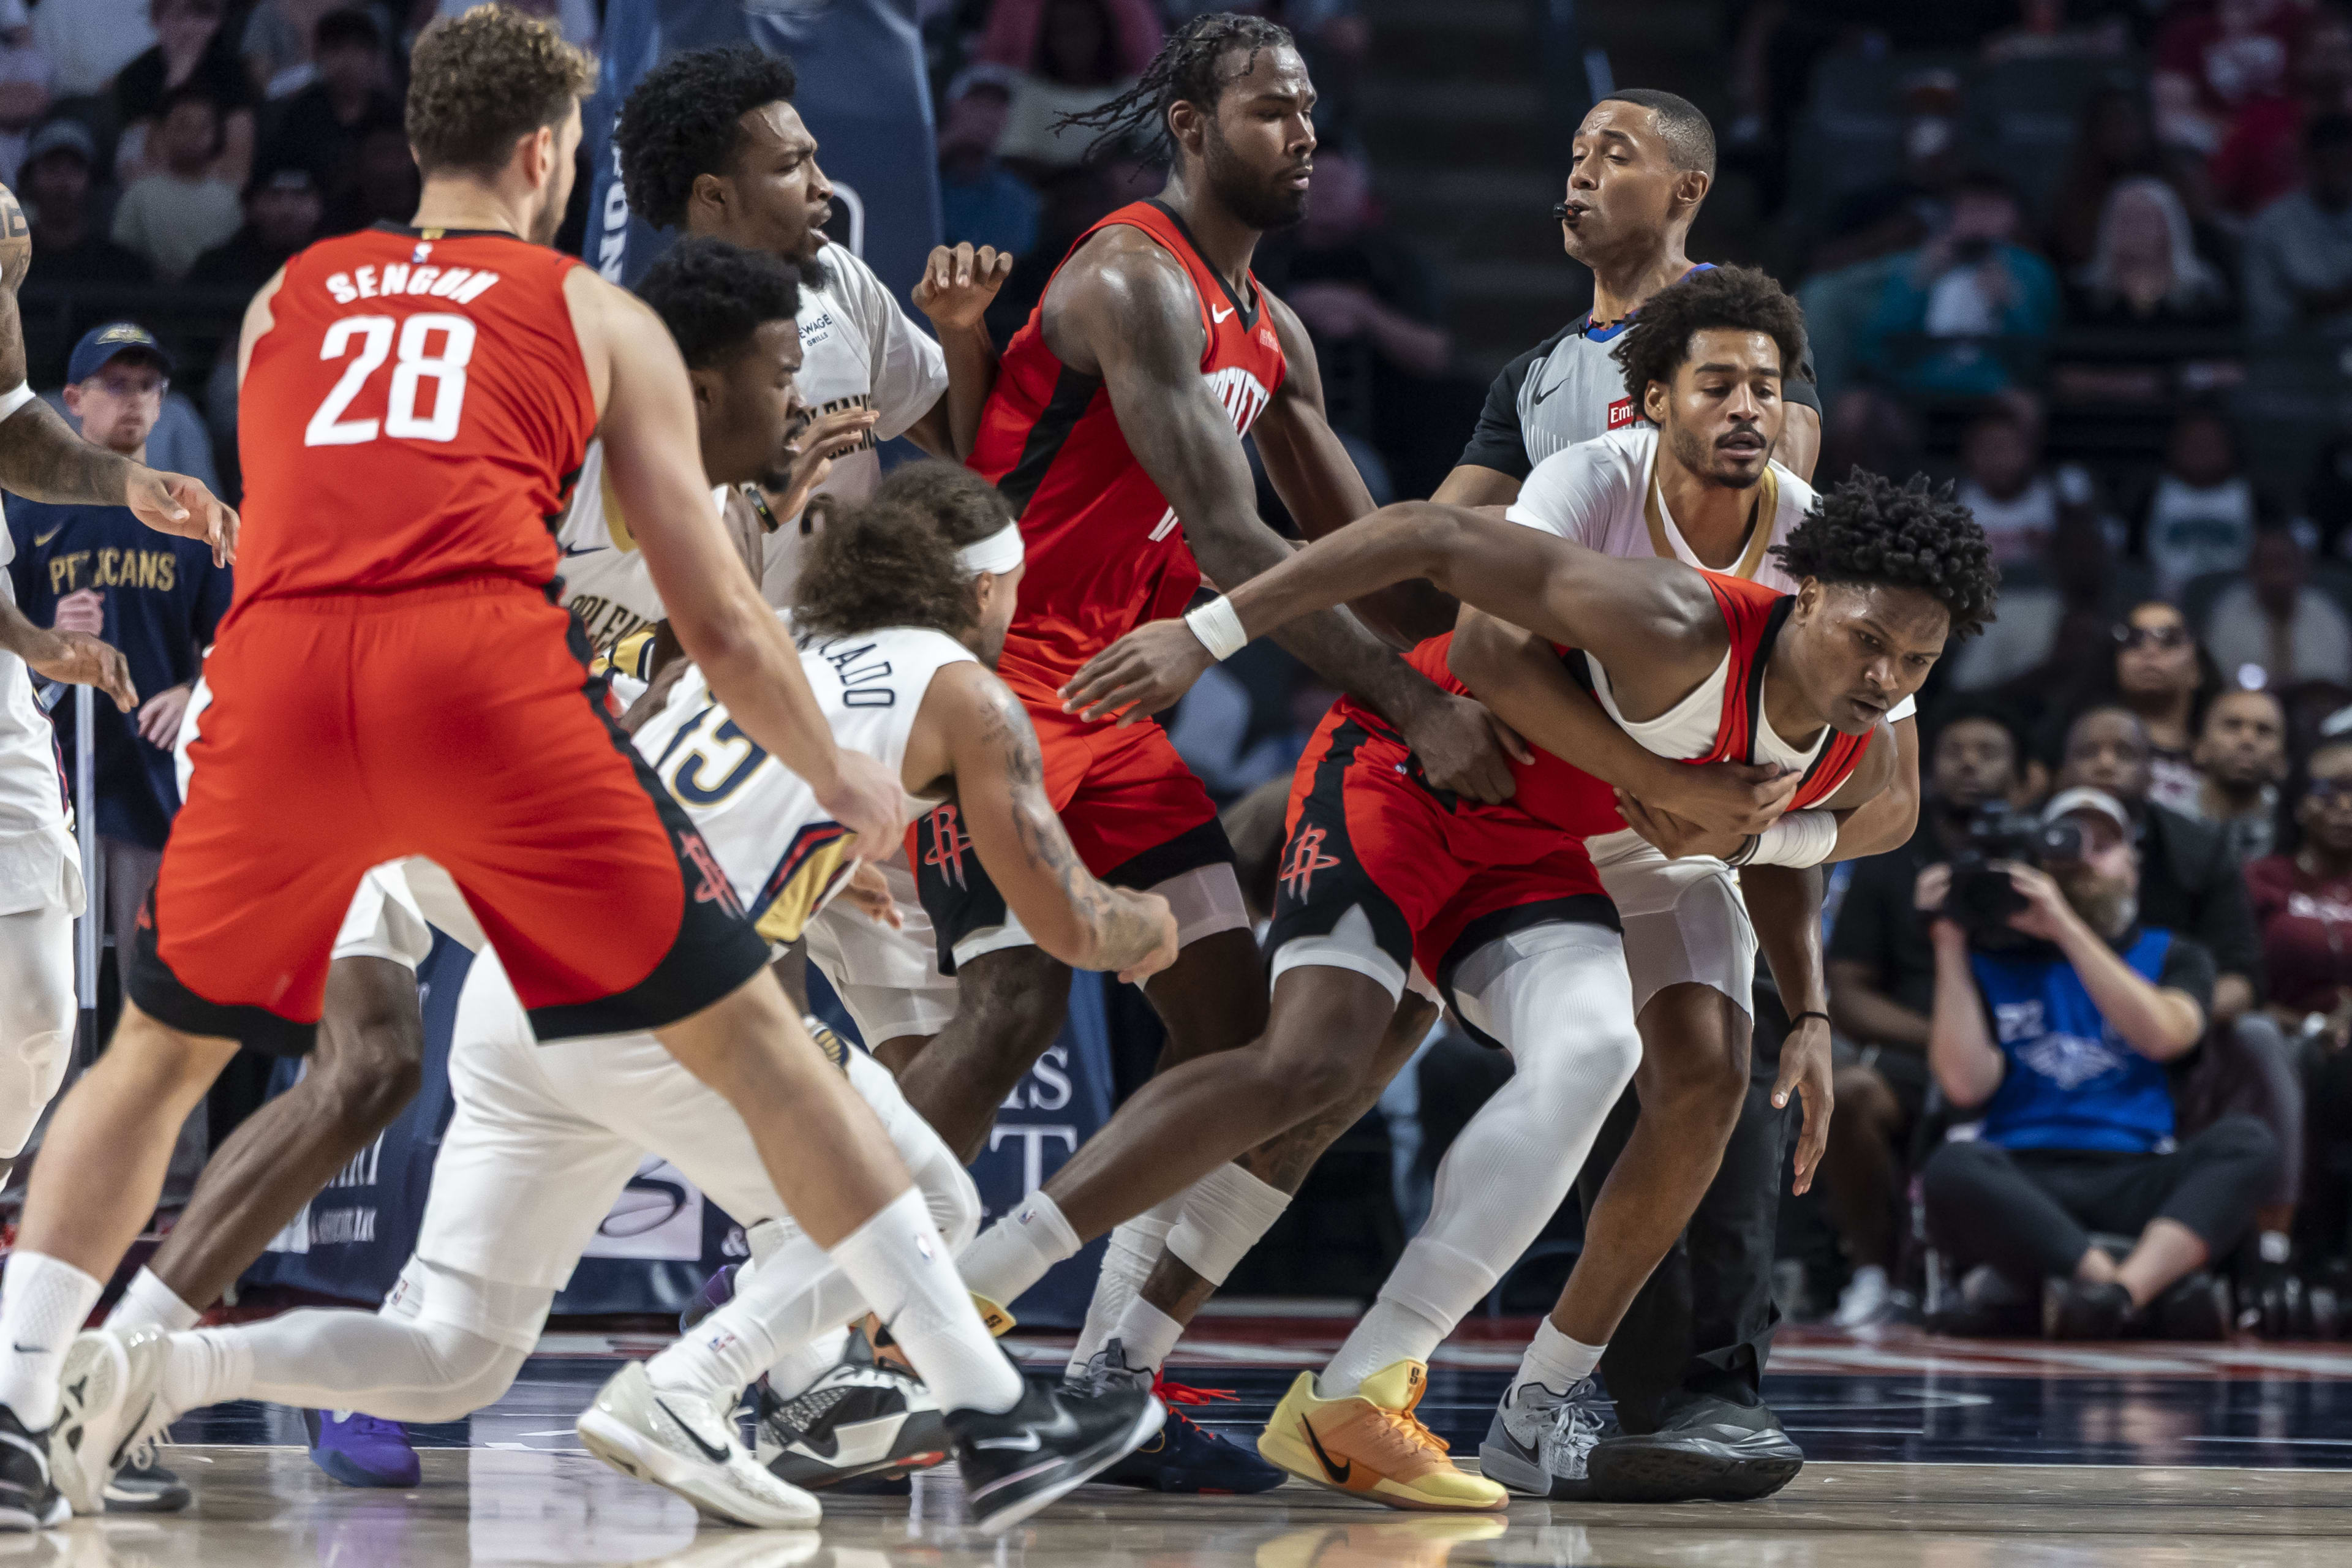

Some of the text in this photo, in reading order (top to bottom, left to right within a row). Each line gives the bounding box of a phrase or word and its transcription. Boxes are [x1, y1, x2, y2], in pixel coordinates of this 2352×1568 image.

[325, 262, 500, 304] SENGUN
[798, 314, 832, 339] EWAGE
[807, 332, 828, 347] GRILLS
[304, 311, 477, 447] 28
[49, 547, 175, 594] PEICANS
